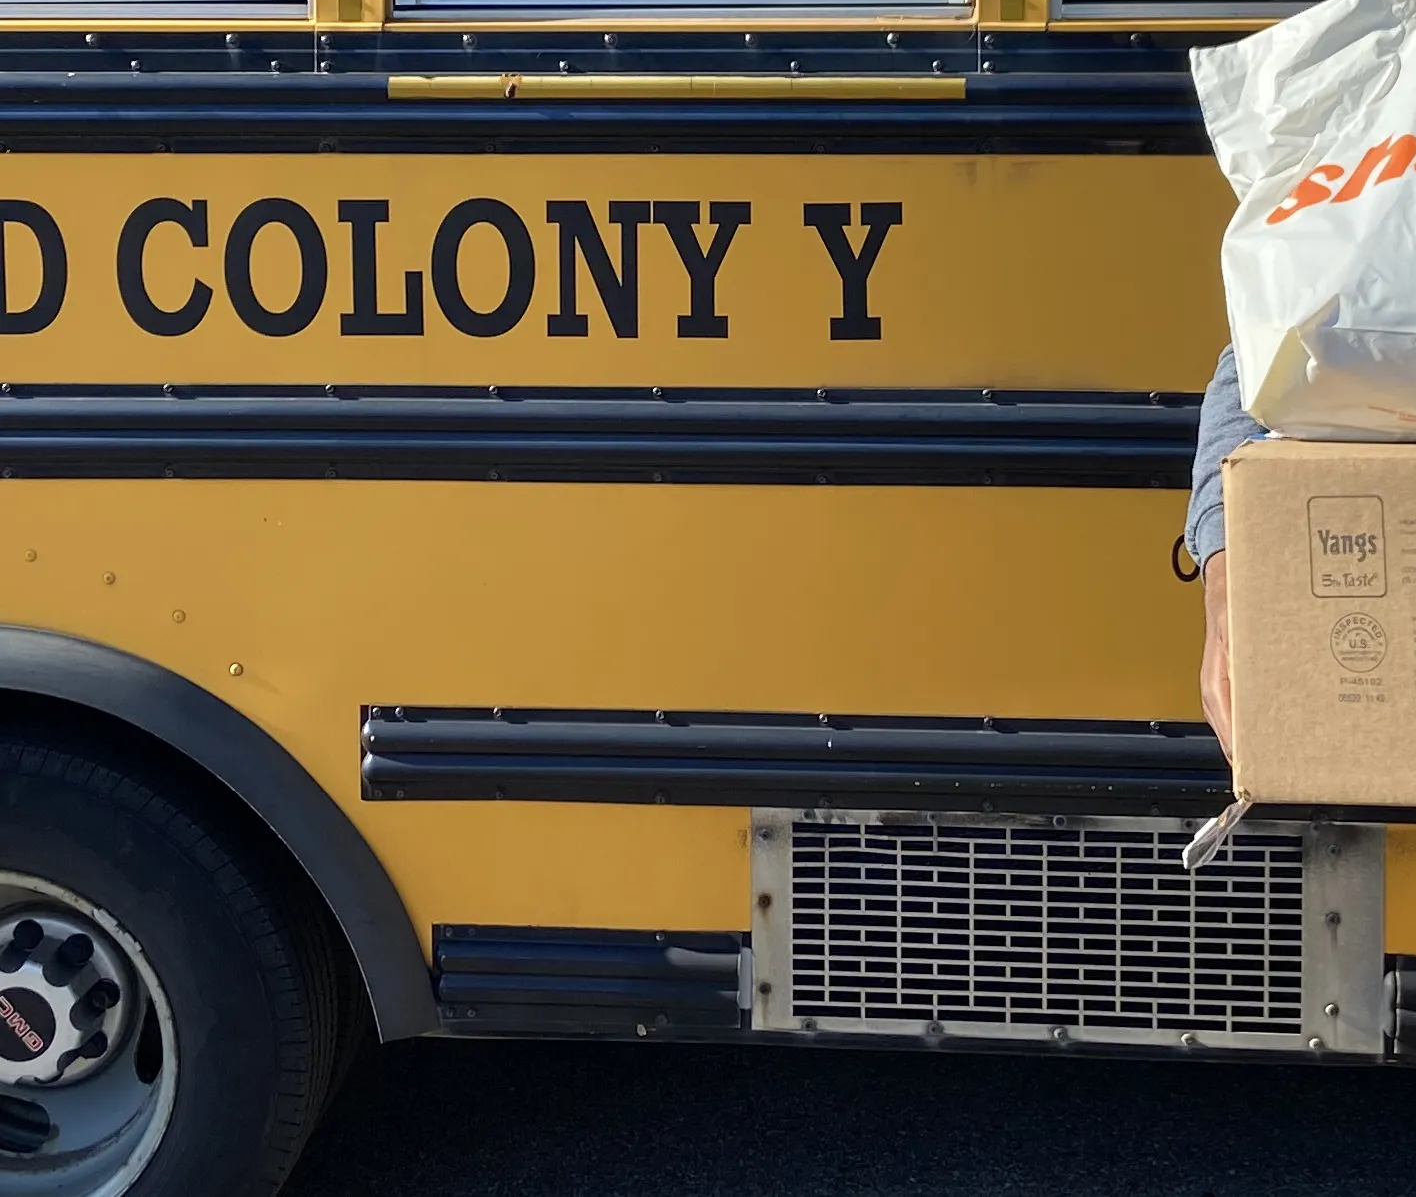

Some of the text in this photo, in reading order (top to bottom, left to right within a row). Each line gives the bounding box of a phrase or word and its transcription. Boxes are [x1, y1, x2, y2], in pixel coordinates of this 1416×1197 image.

[116, 197, 752, 339] COLONY
[804, 202, 904, 341] Y
[1317, 529, 1378, 562] Yangs
[1333, 616, 1383, 640] INSPECTED
[0, 995, 44, 1052] GMC
